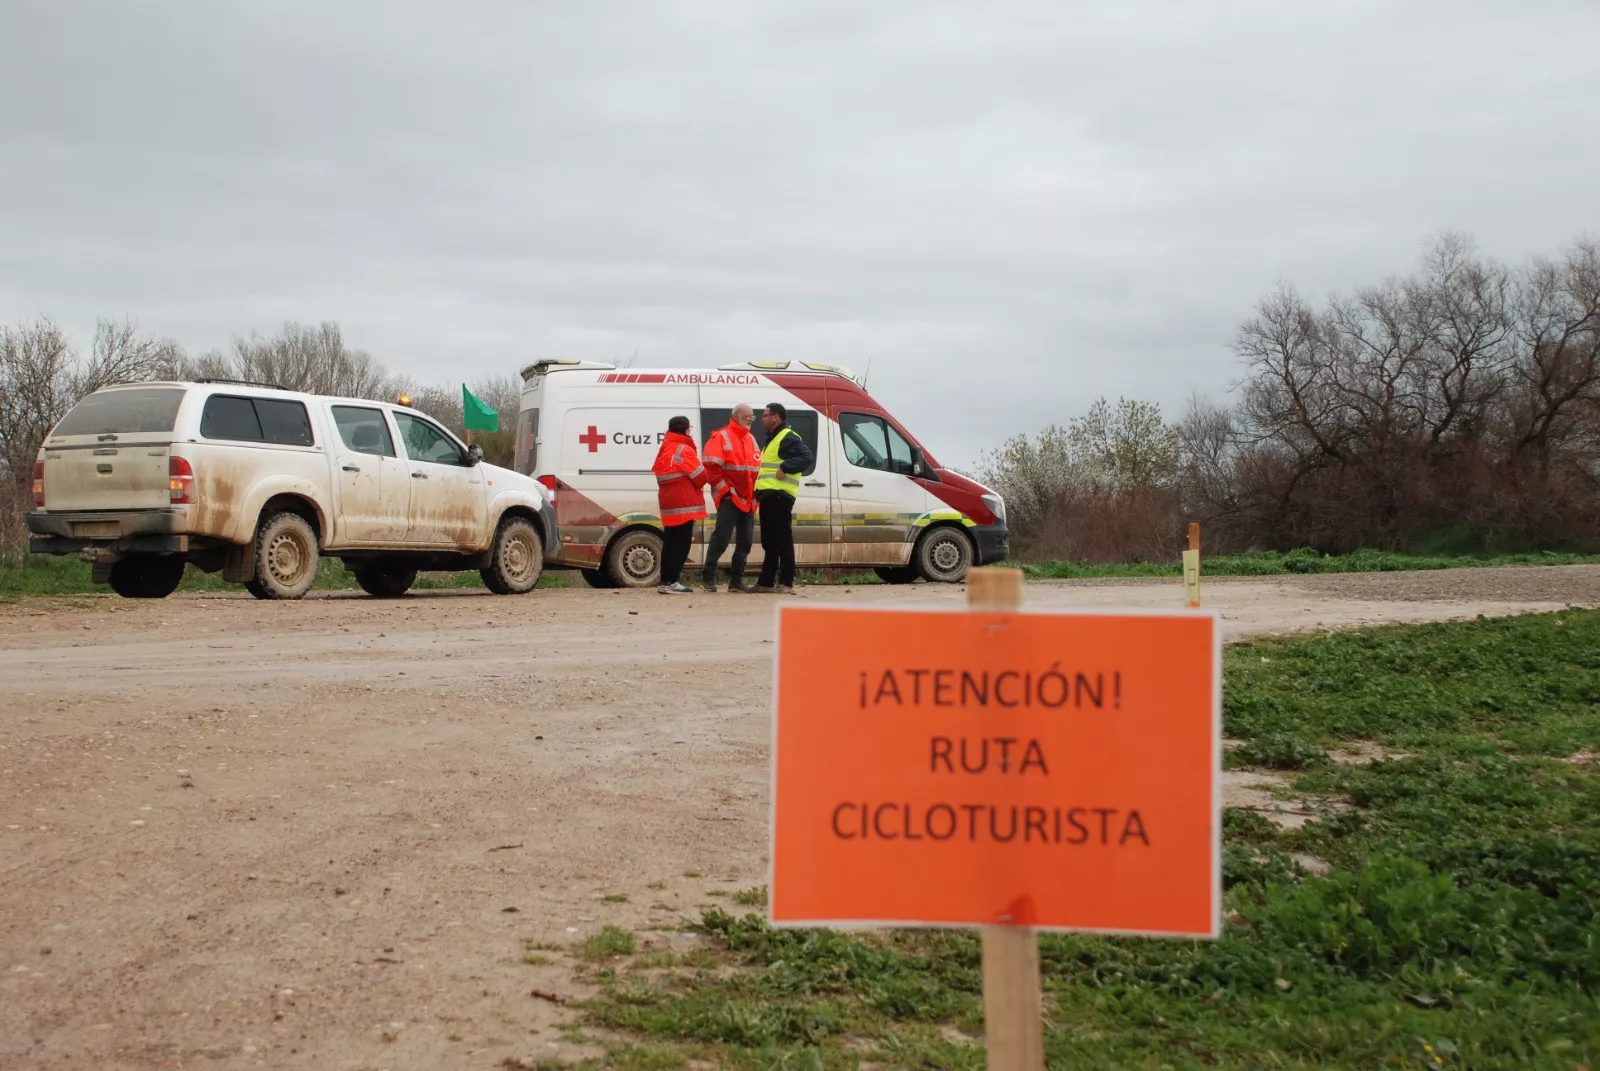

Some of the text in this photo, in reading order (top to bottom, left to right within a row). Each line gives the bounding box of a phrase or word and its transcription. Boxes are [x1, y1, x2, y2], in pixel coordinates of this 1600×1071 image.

[665, 374, 760, 385] AMBULANCIA
[613, 432, 651, 445] Cruz
[859, 661, 1122, 711] ¡ATENCIÓN!
[929, 736, 1049, 776] RUTA
[832, 802, 1151, 847] CICLOTURISTA
